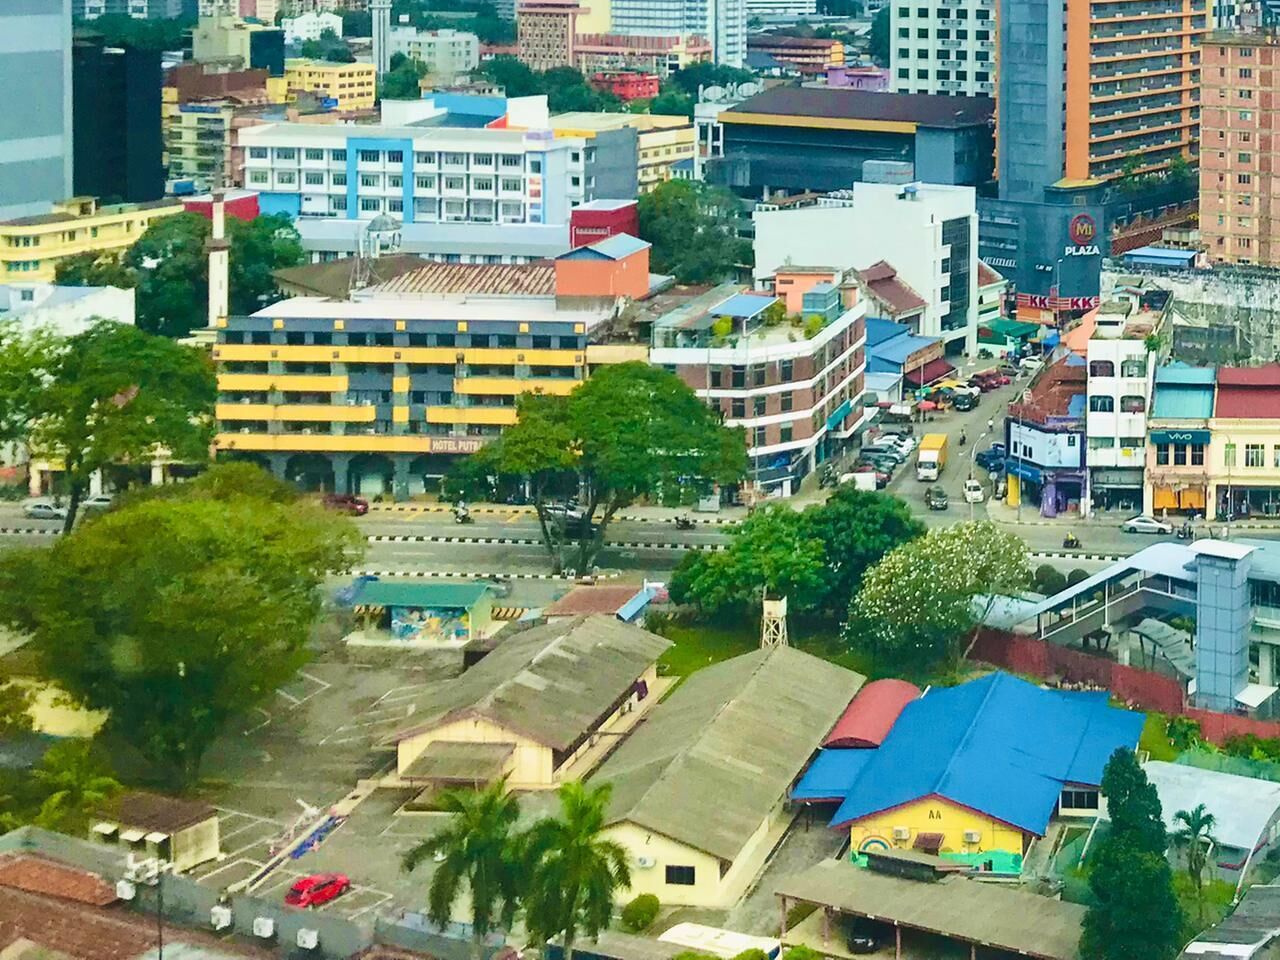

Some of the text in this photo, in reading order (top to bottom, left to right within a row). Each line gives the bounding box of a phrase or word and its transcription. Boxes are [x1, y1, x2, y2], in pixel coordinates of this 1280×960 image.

[1065, 246, 1100, 256] PLAZA
[1030, 295, 1047, 308] KK
[1071, 298, 1093, 309] KK
[432, 440, 457, 451] HOTEL
